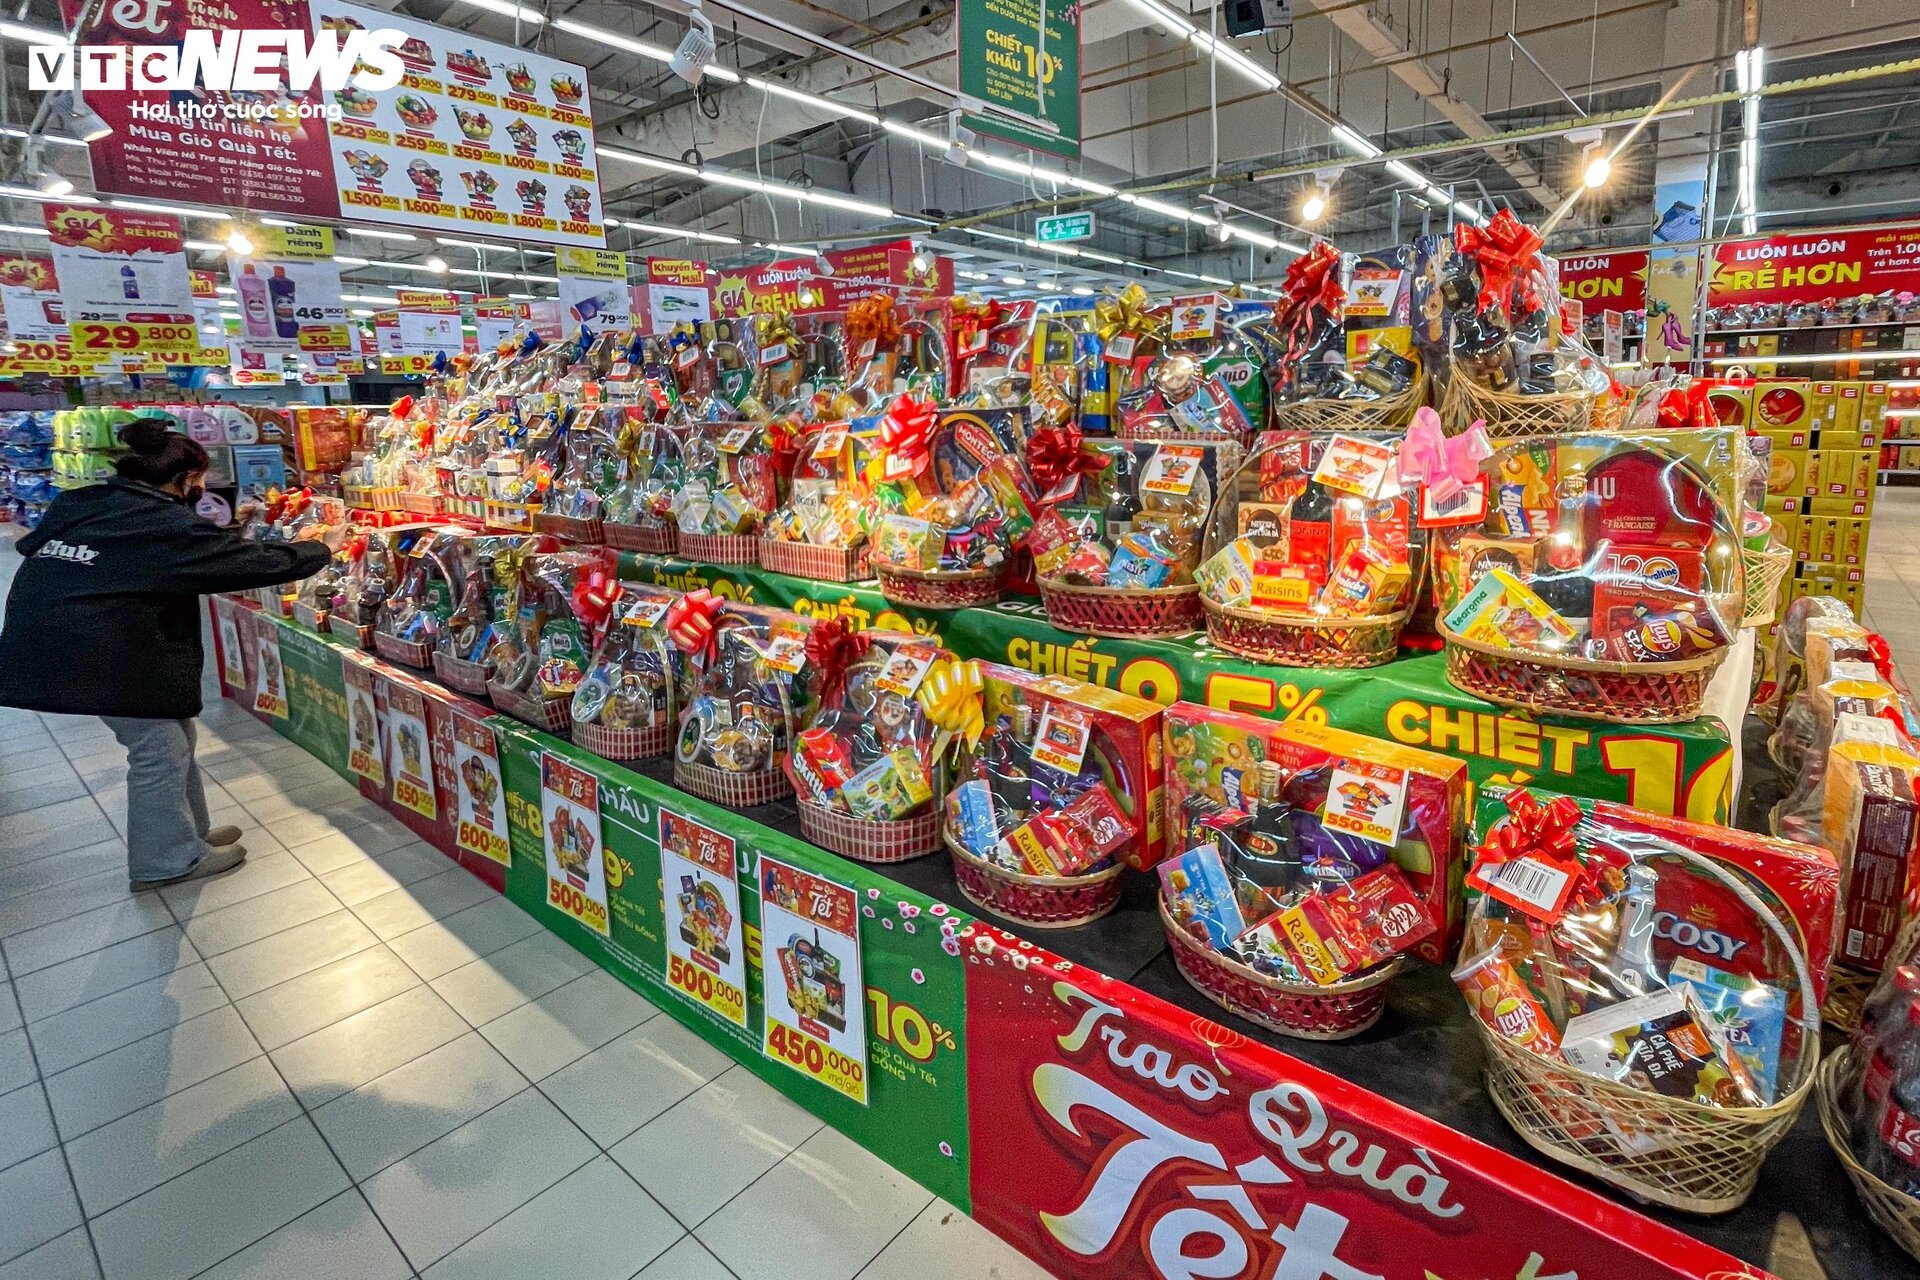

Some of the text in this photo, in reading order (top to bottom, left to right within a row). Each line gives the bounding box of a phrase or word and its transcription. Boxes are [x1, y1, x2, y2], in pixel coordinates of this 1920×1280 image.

[985, 28, 1023, 53] CHIẾT
[985, 48, 1022, 72] KHẤU
[129, 124, 172, 142] Mua
[179, 131, 213, 148] Giỏ
[218, 136, 258, 154] Quà
[231, 121, 265, 139] liên
[1563, 256, 1610, 272] LUÔN
[1736, 238, 1847, 262] LUÔN LUÔN
[757, 268, 785, 286] LUÔN
[1733, 260, 1862, 292] RẺ HƠN
[1256, 580, 1303, 598] Raisins
[1007, 636, 1117, 685] CHIẾT
[1326, 812, 1392, 836] 550.000
[697, 838, 716, 865] Tết
[808, 890, 834, 920] Tết
[1653, 910, 1748, 962] COSY
[669, 958, 744, 1009] 500.000
[866, 985, 957, 1063] 10%
[768, 1022, 864, 1084] 450.000
[871, 1052, 907, 1082] ĐỒNG
[872, 1040, 890, 1059] Giỏ
[893, 1052, 917, 1074] Quà
[1052, 980, 1466, 1220] Trao Quà
[1032, 1062, 1386, 1280] Tết
